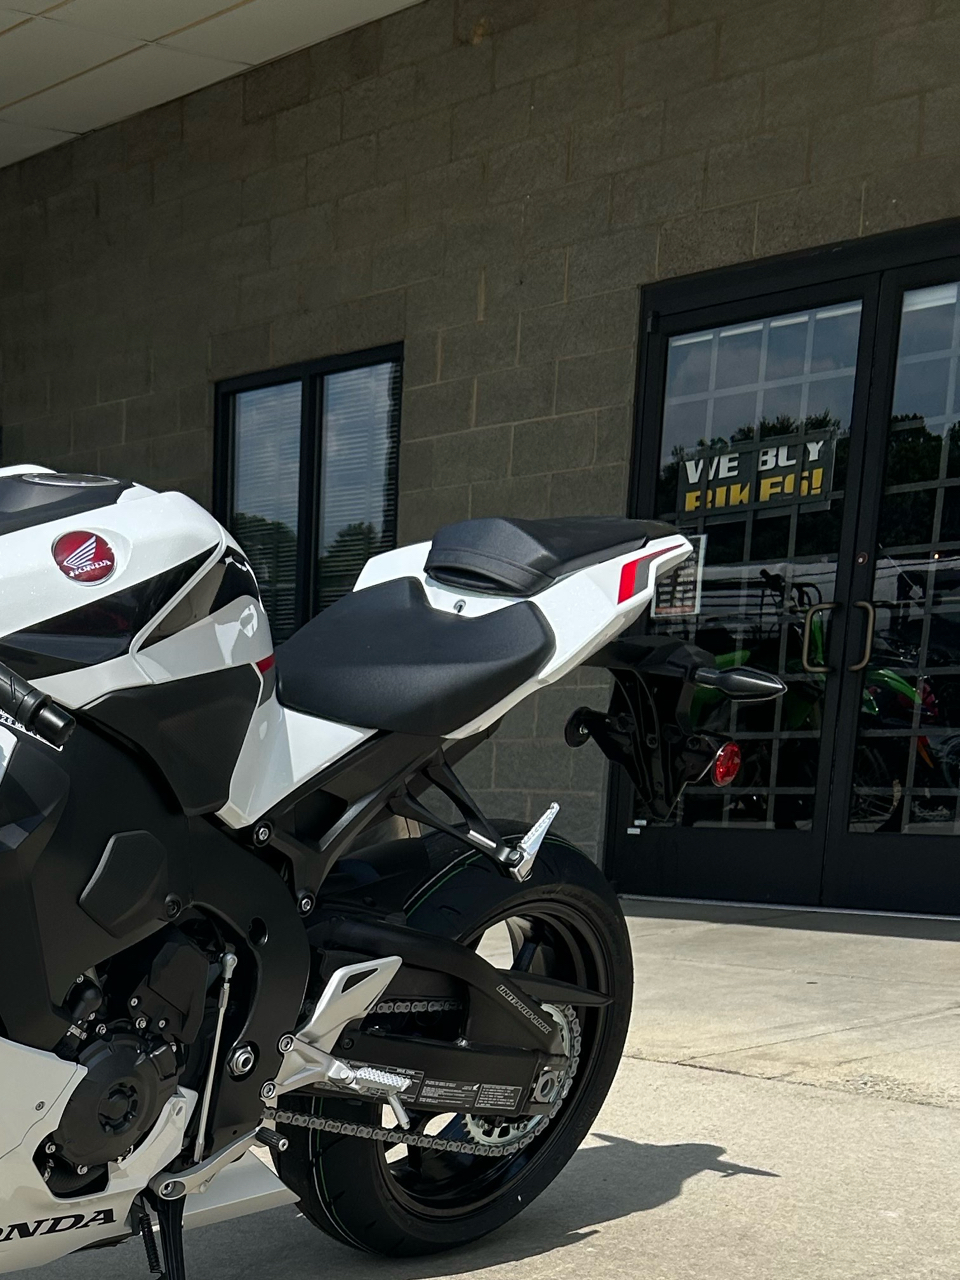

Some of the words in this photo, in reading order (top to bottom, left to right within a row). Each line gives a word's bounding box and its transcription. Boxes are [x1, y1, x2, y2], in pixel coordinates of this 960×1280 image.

[685, 453, 739, 484] WE
[69, 560, 112, 577] HONDA
[496, 984, 519, 1006] UNIT
